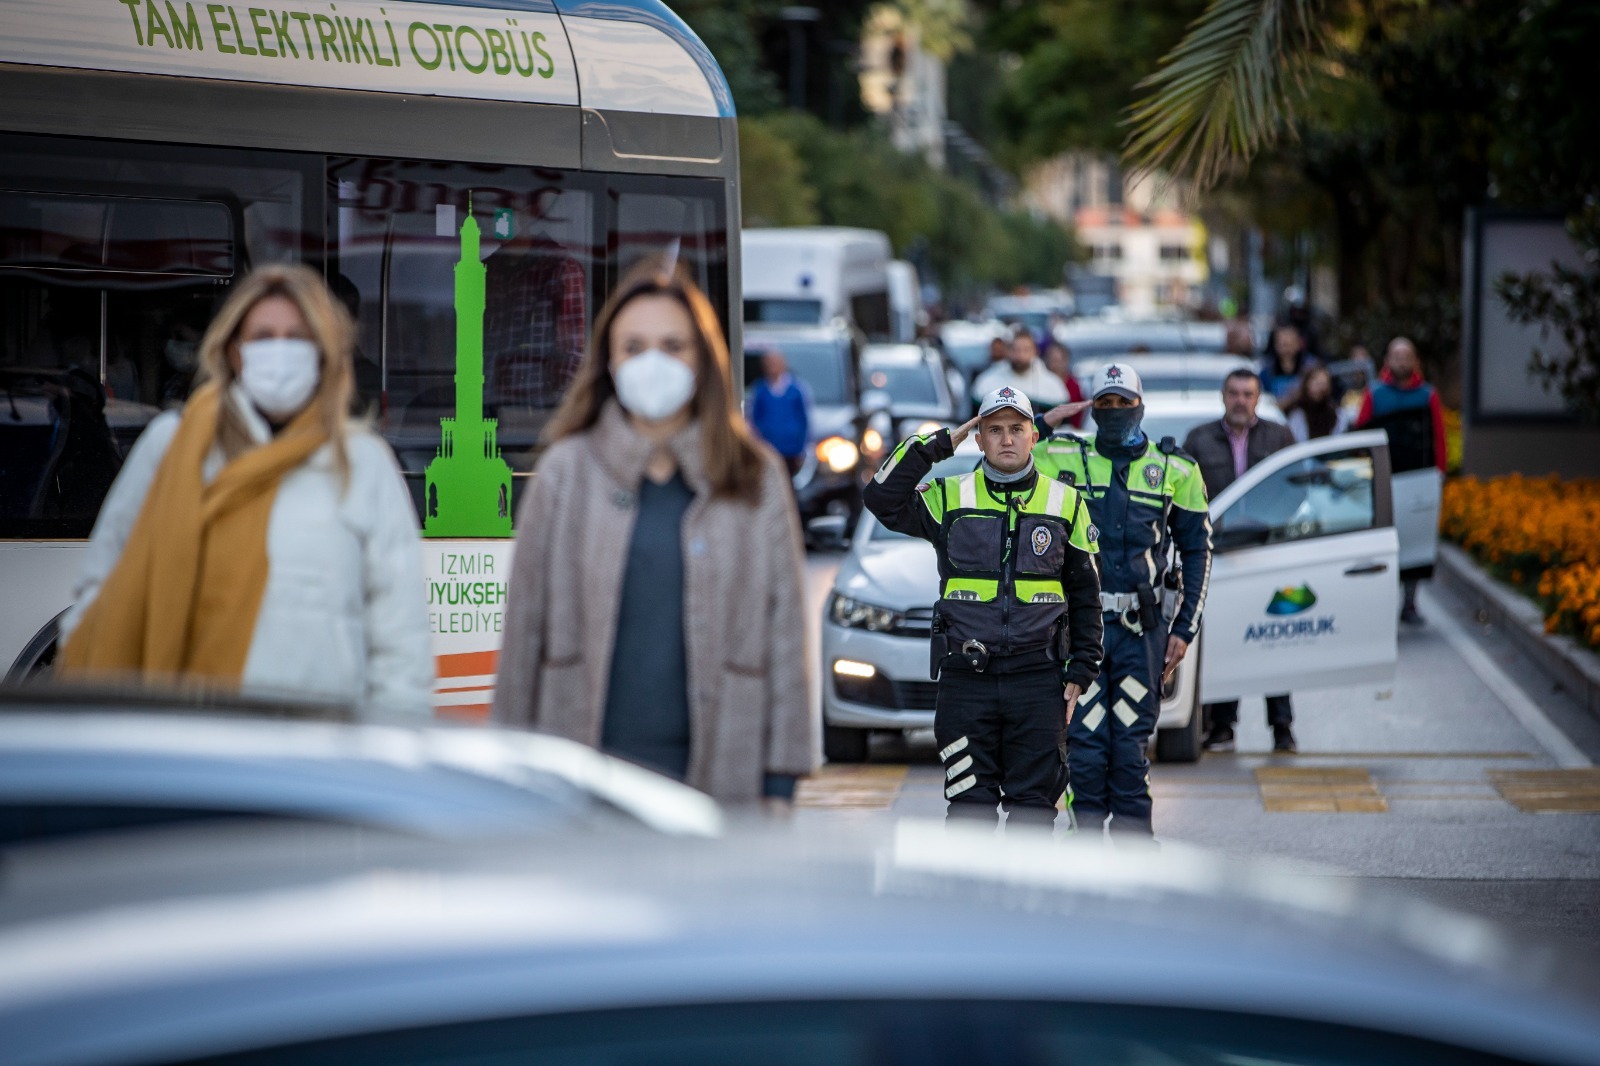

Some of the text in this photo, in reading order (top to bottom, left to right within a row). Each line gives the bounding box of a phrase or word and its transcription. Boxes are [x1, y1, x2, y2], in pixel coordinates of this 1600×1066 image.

[118, 0, 554, 79] TAM ELEKTRİKLİ OTOBÜS
[441, 552, 495, 575] İZMİR
[424, 577, 508, 608] ÜYÜKŞEH
[428, 611, 504, 633] ELEDİYE
[1244, 617, 1335, 642] AKDORUK
